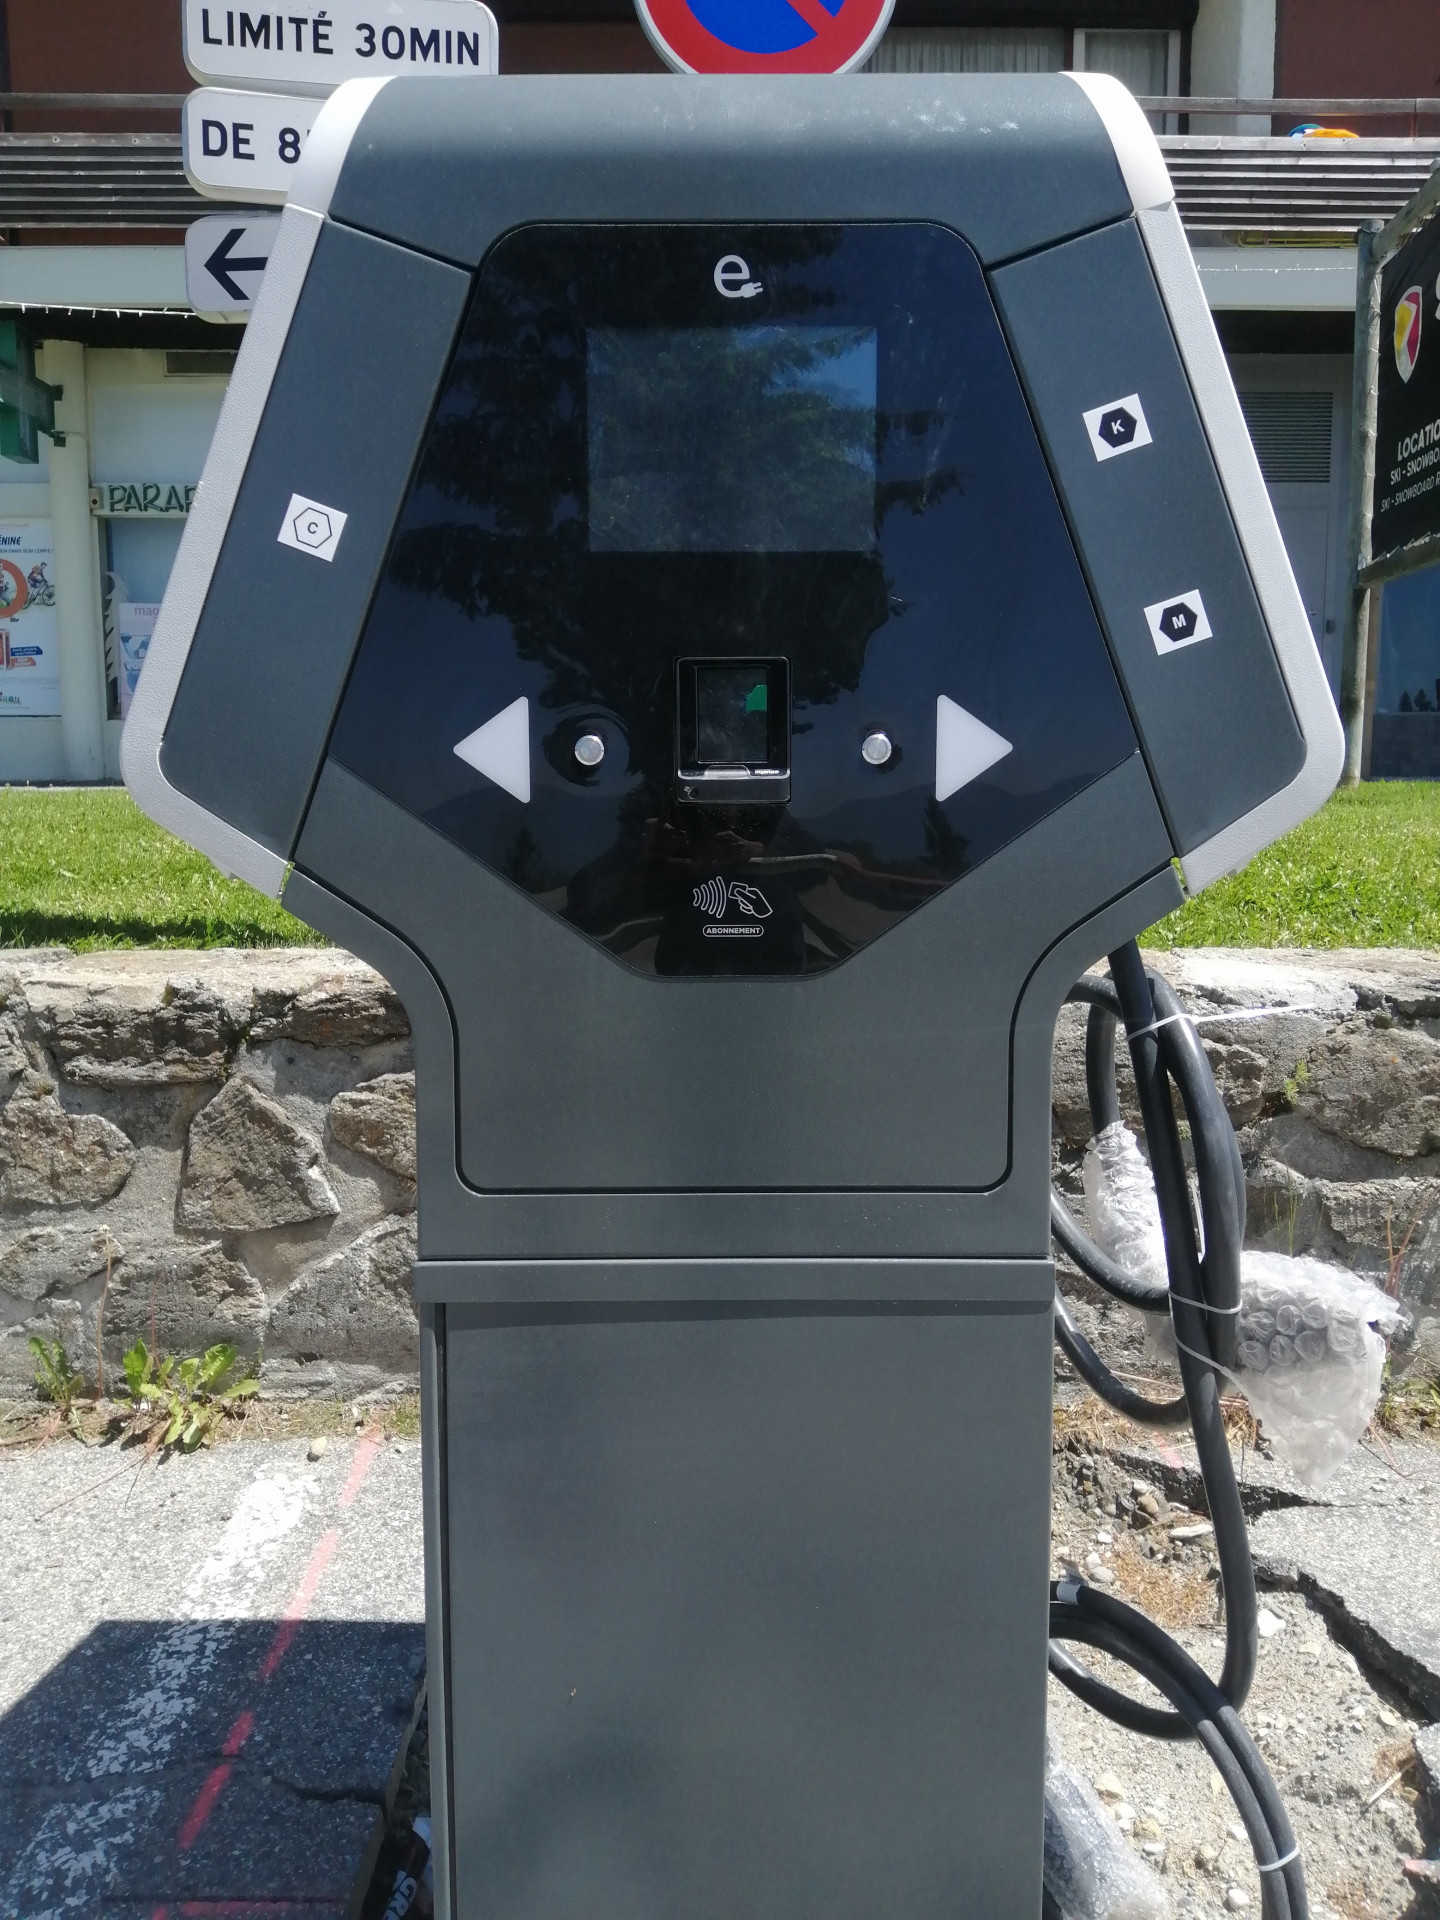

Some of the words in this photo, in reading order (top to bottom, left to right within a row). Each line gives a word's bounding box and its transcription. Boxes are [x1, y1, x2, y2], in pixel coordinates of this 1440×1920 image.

[201, 8, 334, 55] LIMITÉ
[355, 23, 480, 66] 30MIN
[202, 119, 255, 161] DE
[278, 127, 312, 164] 8
[1111, 419, 1125, 435] K
[1397, 418, 1440, 462] LOCATIO
[1390, 467, 1401, 486] SKI
[1407, 447, 1440, 477] SNOWBO
[307, 521, 319, 535] C
[1171, 613, 1187, 629] M
[706, 927, 761, 935] ABONNEMENT
